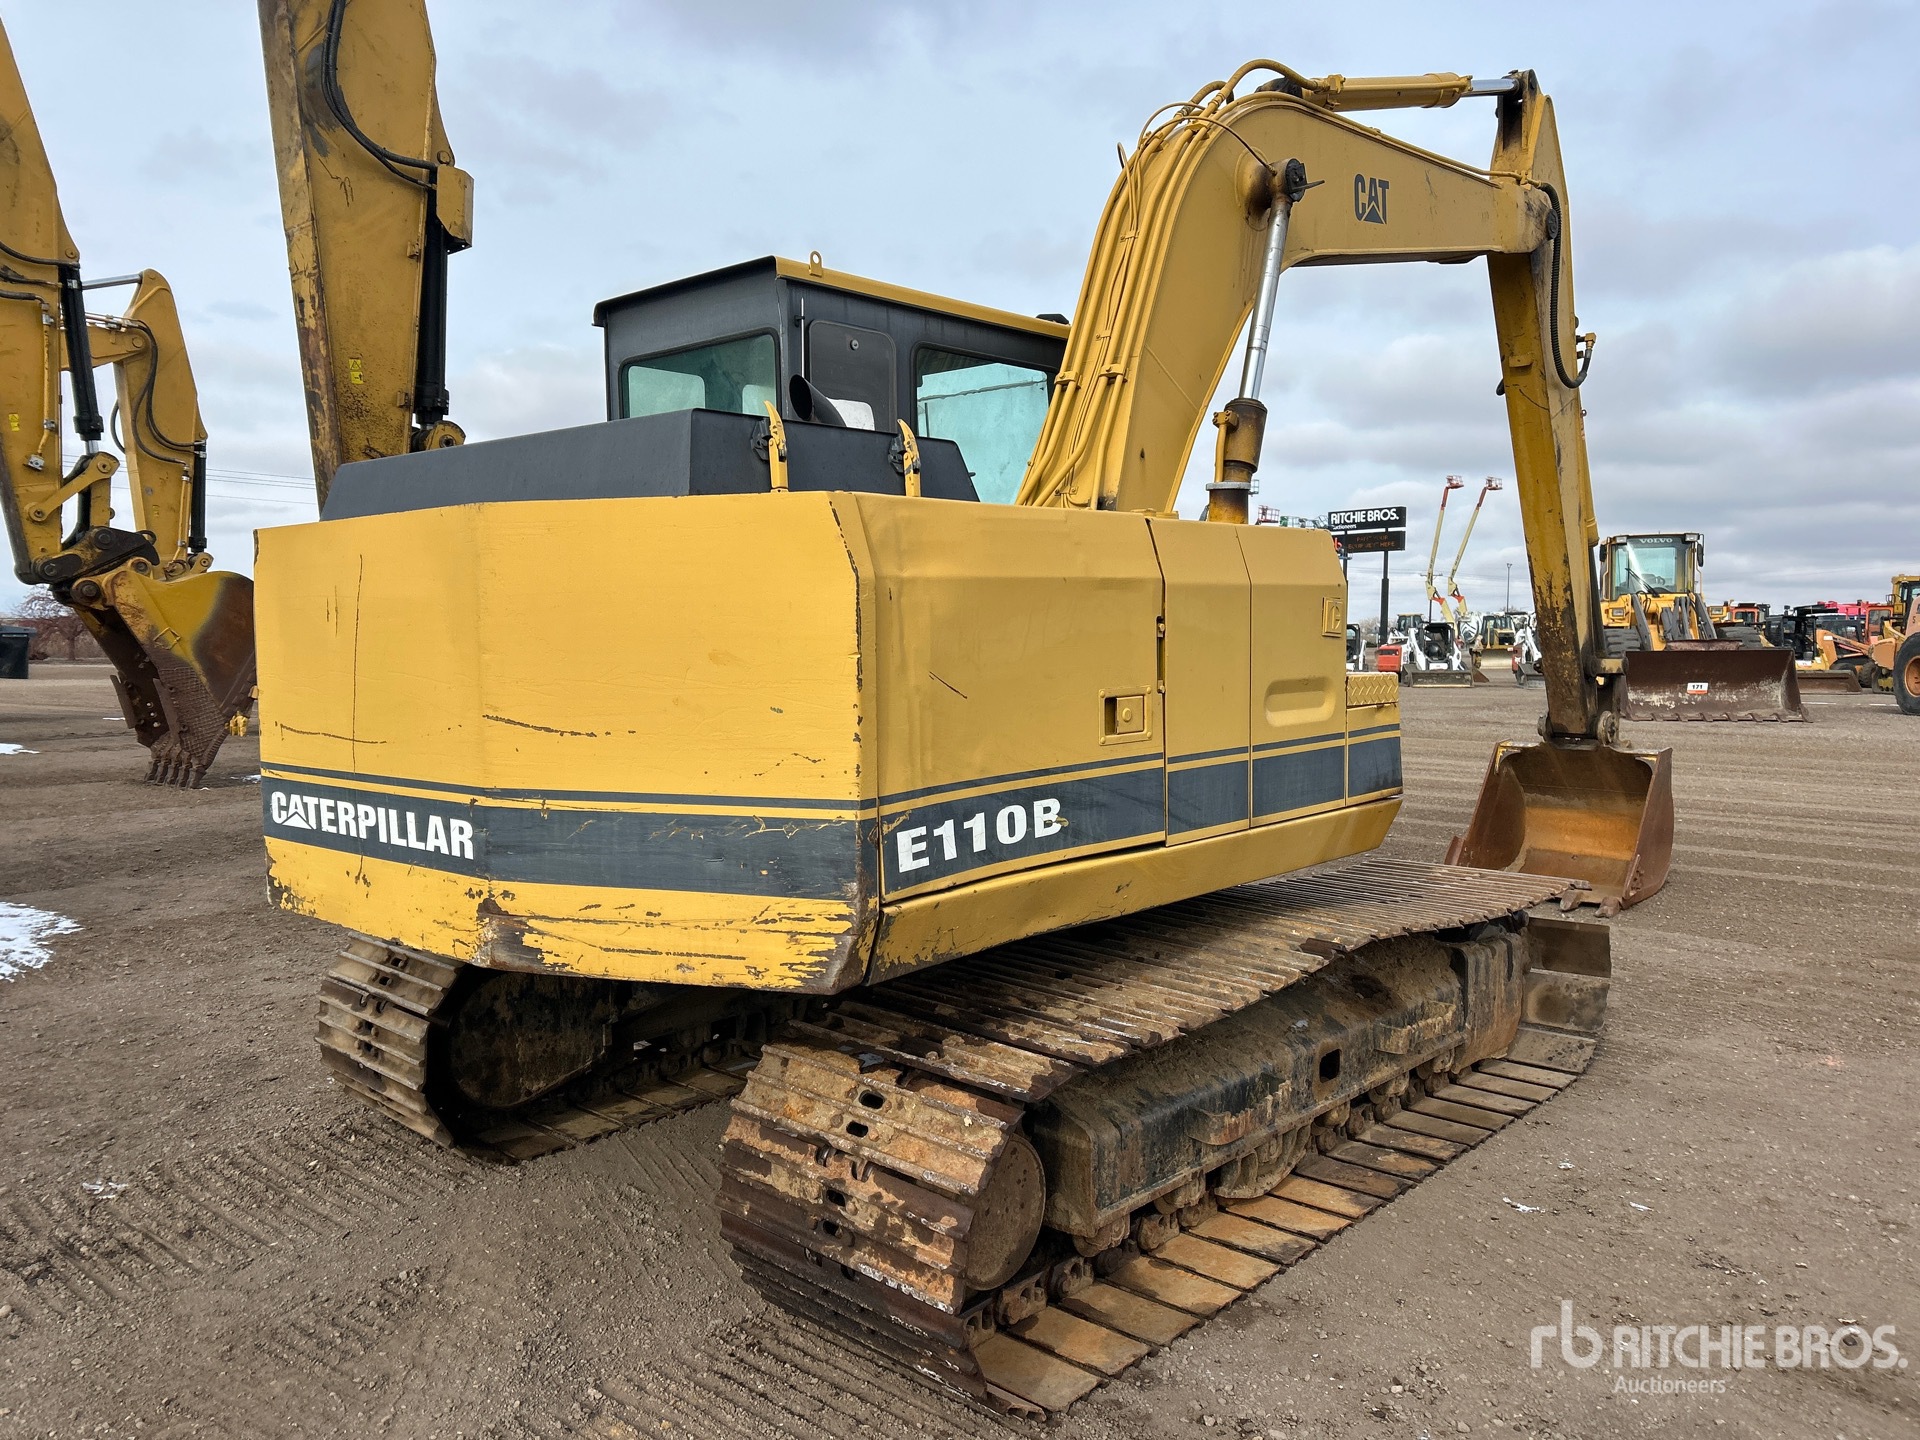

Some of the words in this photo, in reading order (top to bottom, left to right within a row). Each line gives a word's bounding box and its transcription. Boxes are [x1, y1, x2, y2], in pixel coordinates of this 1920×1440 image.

[1354, 173, 1389, 224] CAT
[1331, 511, 1366, 524] RITCHIE
[1367, 508, 1399, 522] BROS.
[271, 791, 474, 860] CATERPILLAR
[897, 798, 1062, 873] E110B
